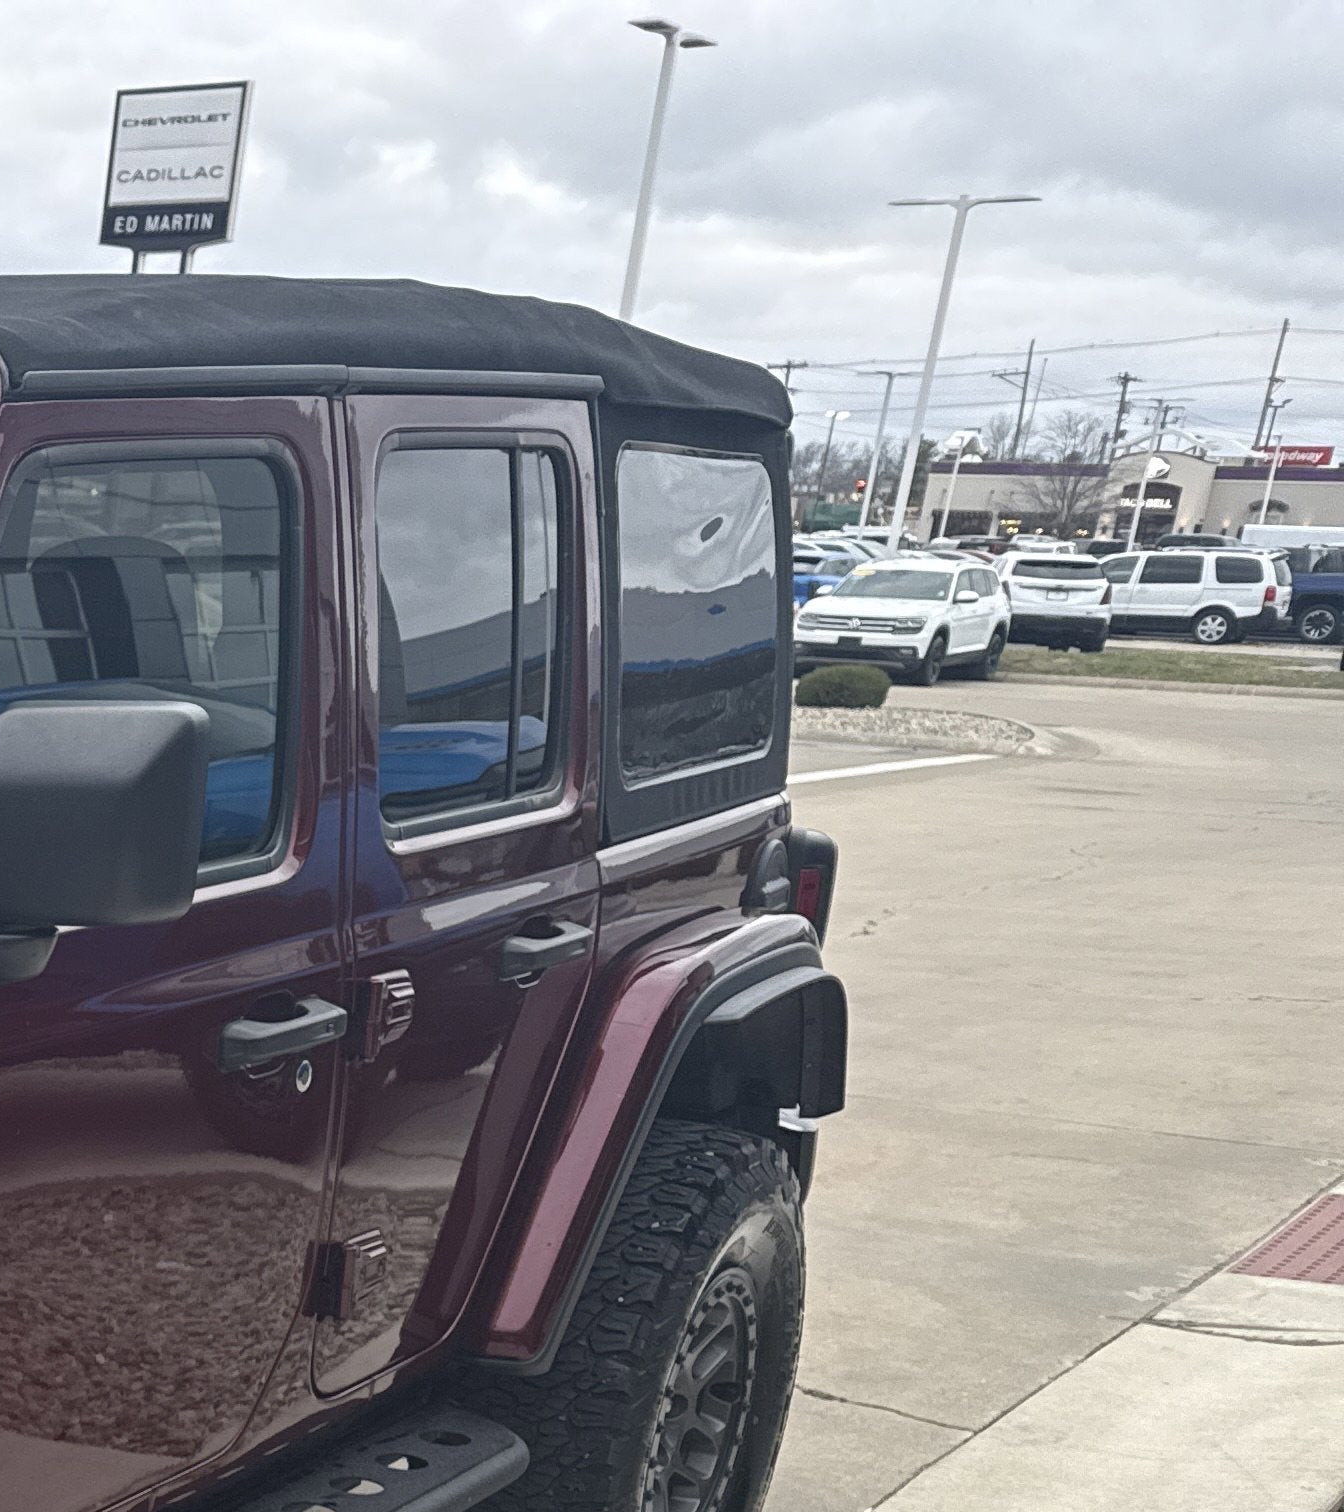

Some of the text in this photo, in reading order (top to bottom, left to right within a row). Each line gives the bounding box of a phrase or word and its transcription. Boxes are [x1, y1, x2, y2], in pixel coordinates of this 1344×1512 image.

[121, 112, 231, 128] CHEVROLET
[116, 165, 225, 183] CADILLAC
[113, 212, 214, 234] ED MARTIN
[1263, 450, 1325, 464] pdway
